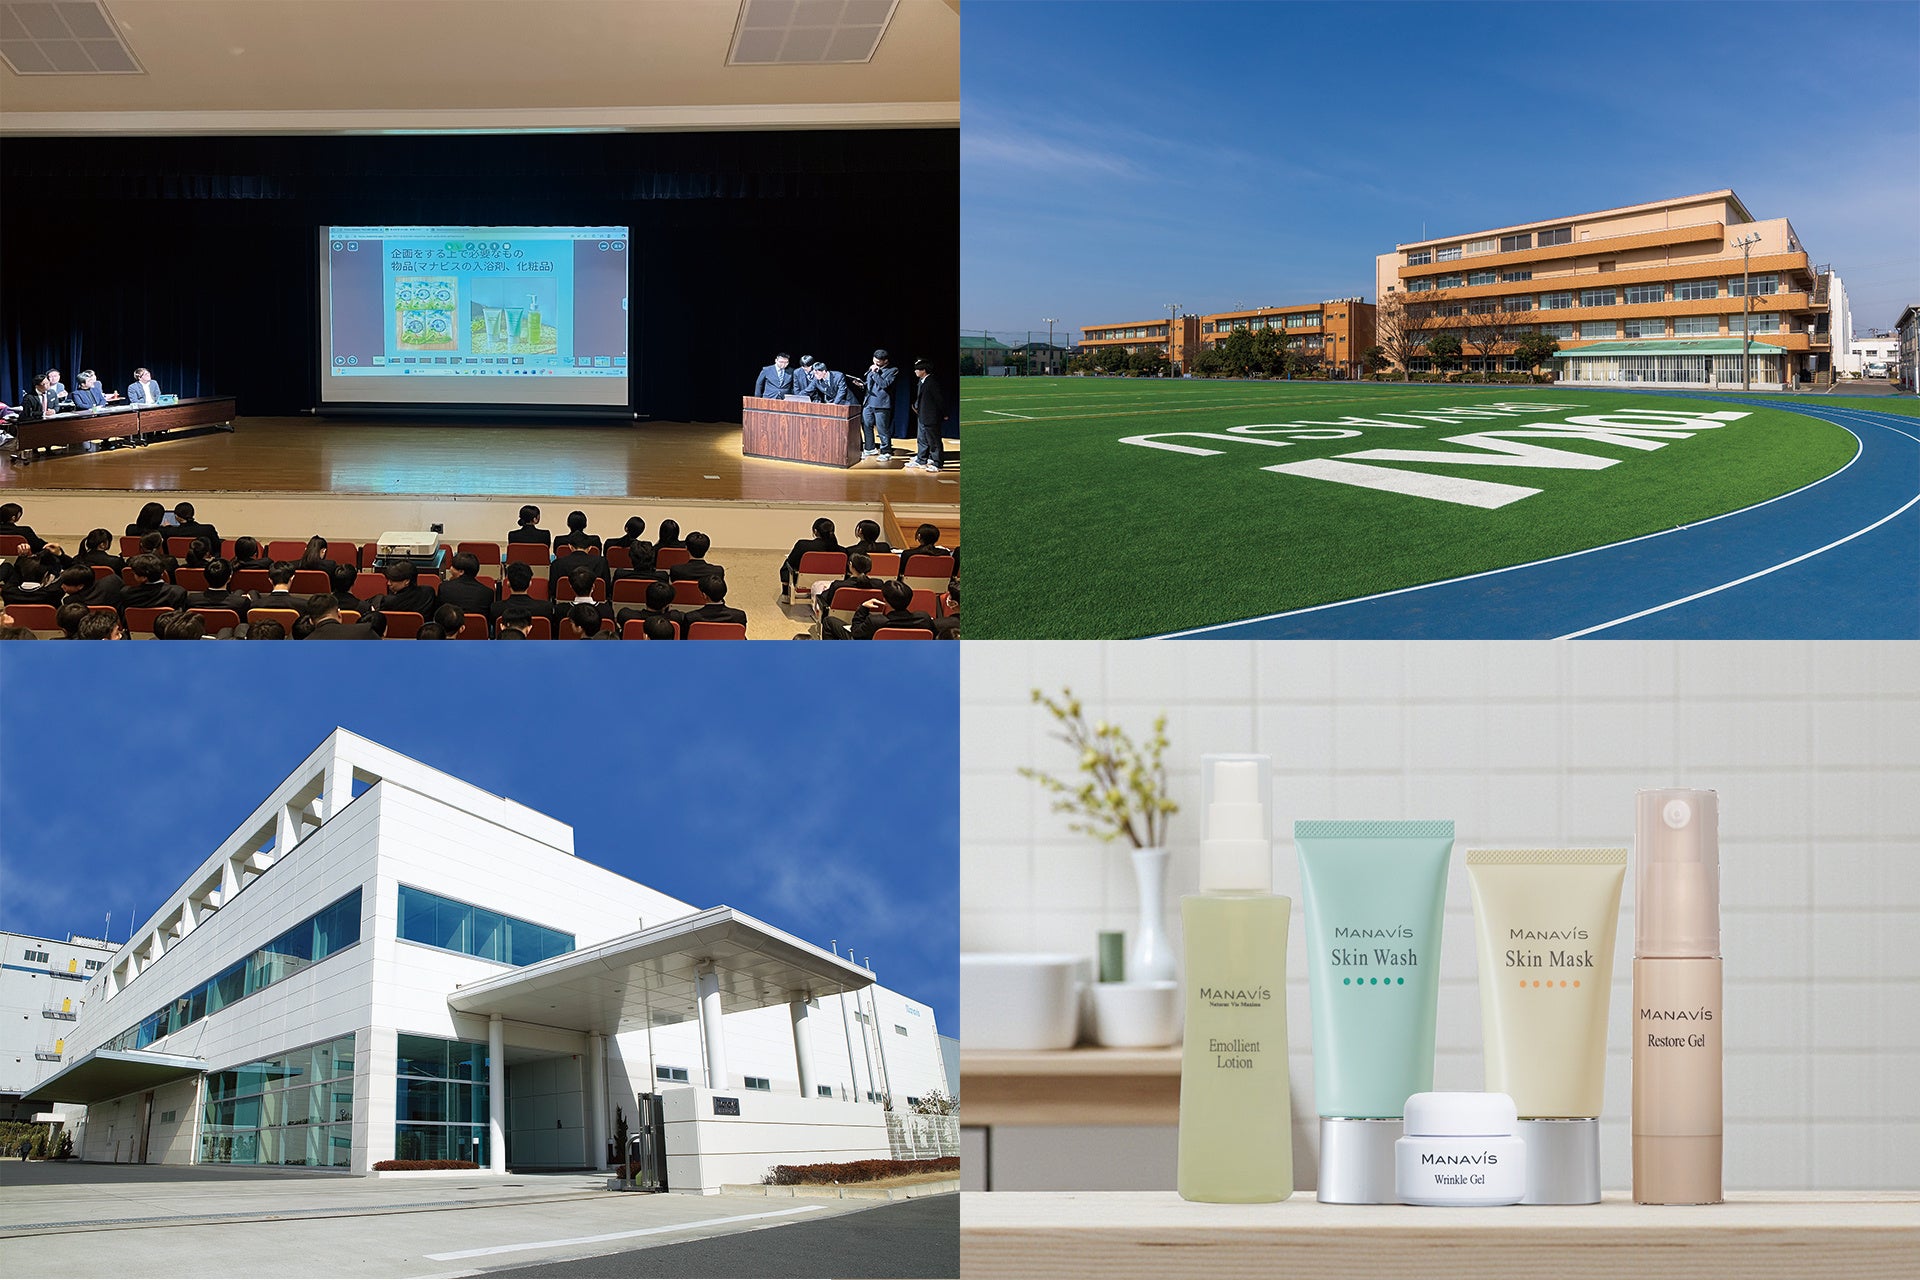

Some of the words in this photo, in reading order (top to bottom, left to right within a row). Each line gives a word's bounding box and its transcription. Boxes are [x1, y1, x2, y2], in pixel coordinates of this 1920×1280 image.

[391, 248, 523, 259] 企画をする上で必要なもの
[1117, 401, 1591, 456] URAYASU
[1259, 408, 1755, 509] TOKAI
[1331, 948, 1368, 966] Skin
[1373, 948, 1418, 966] Wash
[1505, 950, 1542, 967] Skin
[1549, 950, 1594, 967] Mask
[1209, 1038, 1260, 1052] Emollient
[1648, 1033, 1686, 1047] Restore
[1688, 1033, 1705, 1047] Gel
[1217, 1054, 1253, 1069] Lotion
[1434, 1174, 1468, 1185] Wrinkle
[1469, 1174, 1485, 1185] Gel
